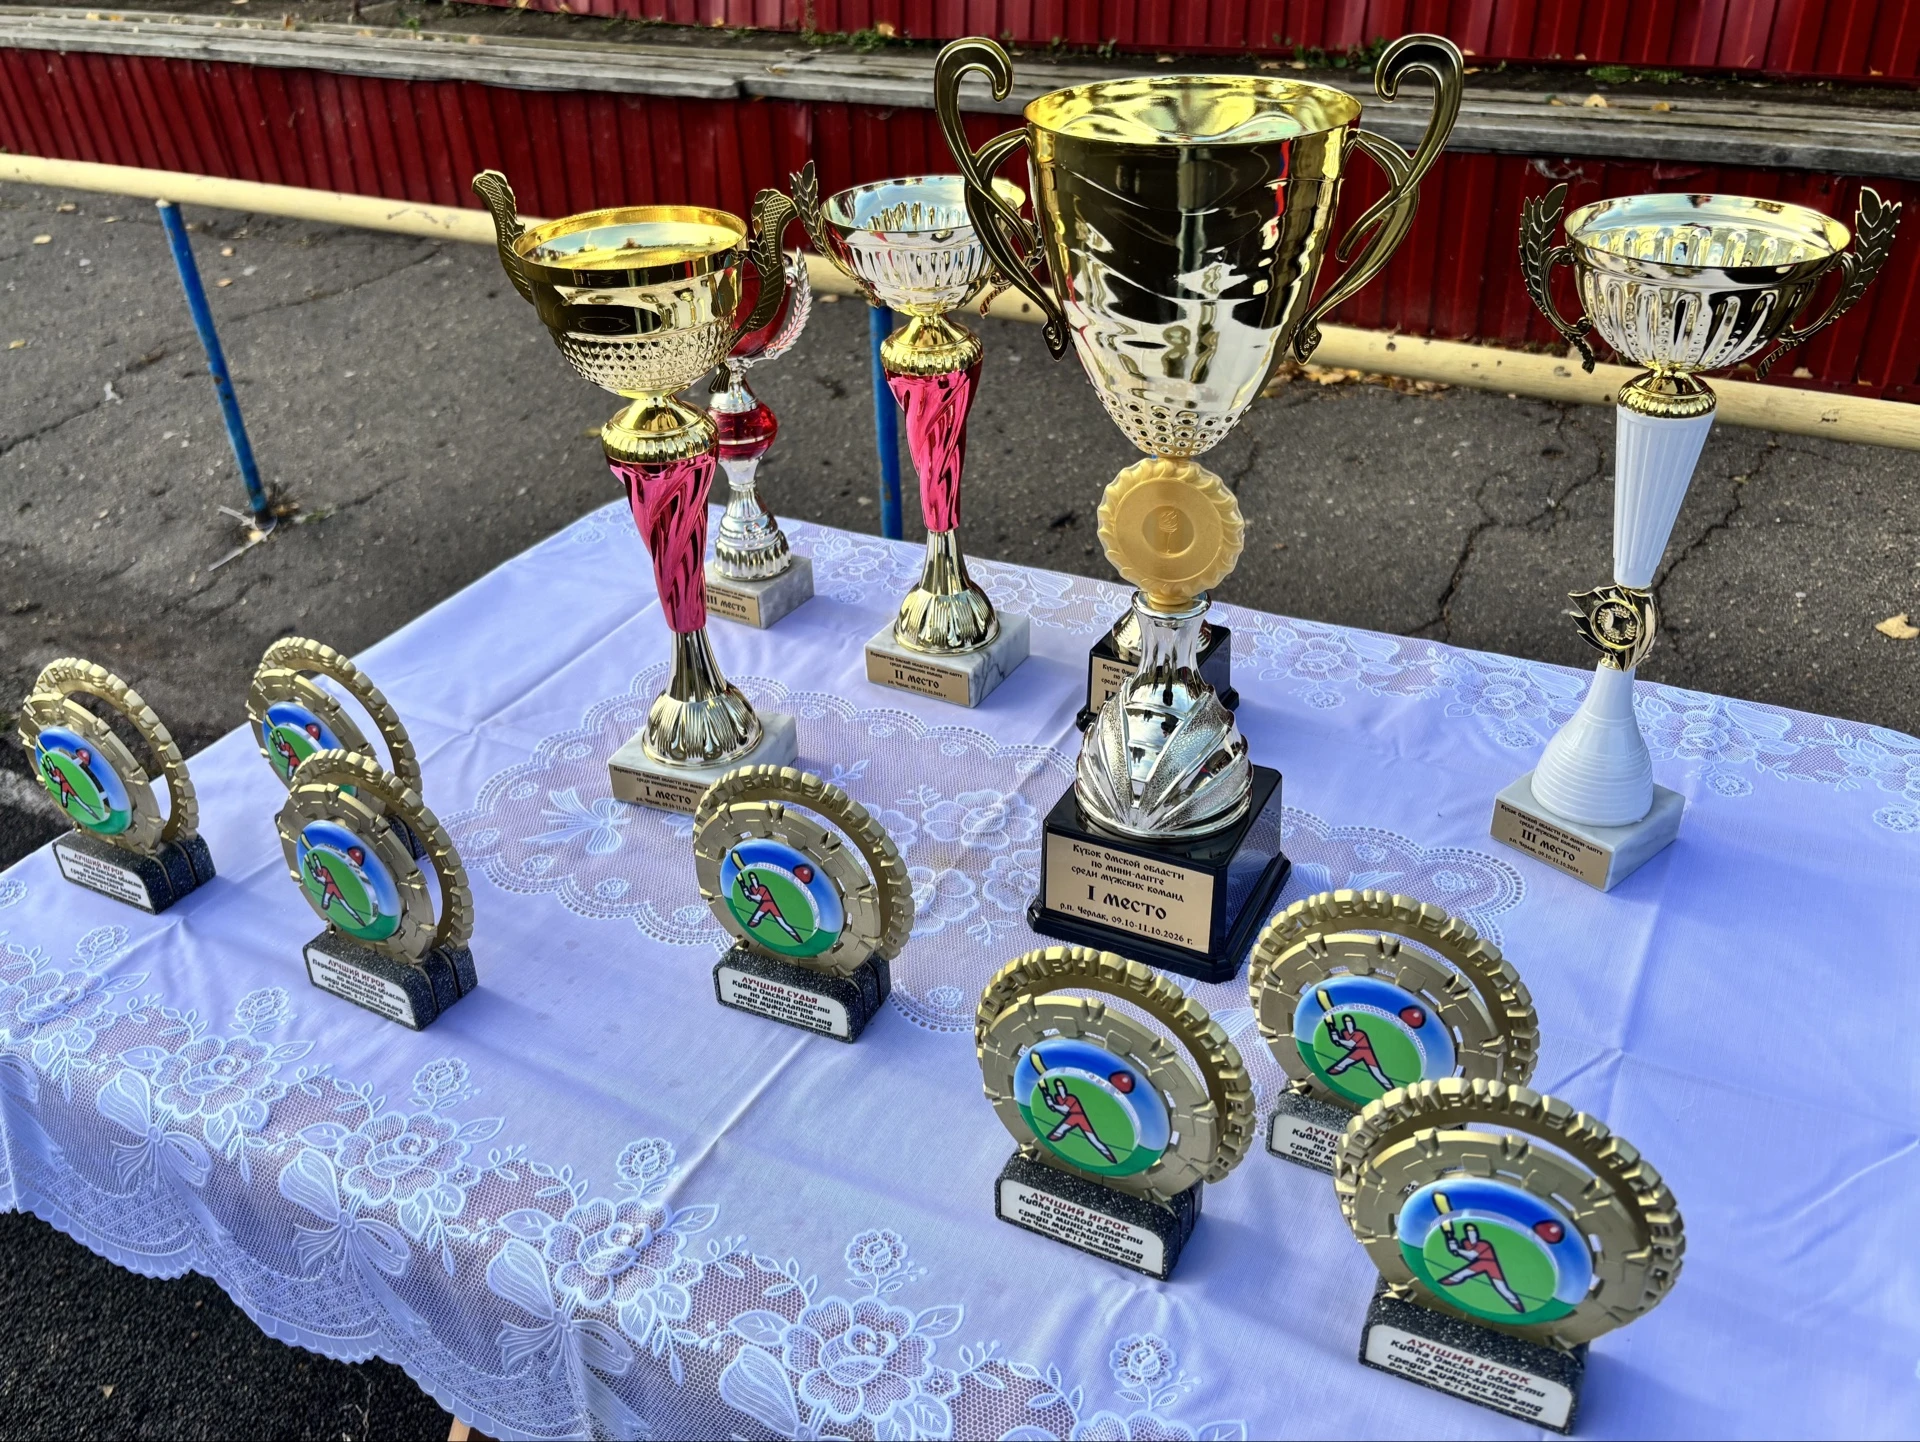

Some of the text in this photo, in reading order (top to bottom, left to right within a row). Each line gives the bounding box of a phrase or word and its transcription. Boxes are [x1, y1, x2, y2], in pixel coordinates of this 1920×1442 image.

[720, 600, 746, 612] место
[894, 669, 940, 689] II место
[1101, 678, 1118, 687] среди
[1102, 664, 1120, 674] Кубок
[645, 786, 692, 805] I место
[1500, 804, 1516, 816] Кубок
[1518, 812, 1538, 825] Омской
[1538, 822, 1561, 836] области
[1570, 837, 1603, 856] мини-лапте
[1519, 820, 1581, 853] среди мужских команд
[1521, 828, 1576, 862] III место
[1073, 844, 1185, 881] Кубок Омской области
[1091, 860, 1164, 886] по мини-лапте
[1072, 866, 1184, 903] среди мужских команд
[1087, 884, 1167, 920] I место
[1060, 902, 1074, 912] р.п.
[1077, 905, 1108, 922] Черлак,
[1112, 915, 1184, 943] 09.10-11.10.2026
[328, 959, 386, 989] ЛУЧШИЙ ИГРОК
[352, 976, 376, 991] Омской
[378, 988, 406, 1003] области
[742, 976, 818, 1004] ЛУЧШИЙ СУДЬЯ
[322, 974, 340, 987] среди
[379, 998, 403, 1014] команд
[732, 979, 830, 1014] Кубка Омской области
[733, 992, 832, 1027] среди мужских команд
[762, 996, 814, 1015] мини-лапте
[1290, 1142, 1322, 1157] среди
[1292, 1128, 1325, 1144] Кубка
[1314, 1144, 1326, 1152] по
[1018, 1194, 1144, 1246] Кубка Омской области
[1031, 1192, 1131, 1234] ЛУЧШИЙ ИГРОК
[1040, 1210, 1121, 1244] по мини-лапте
[1018, 1208, 1144, 1260] среди мужских команд
[1032, 1221, 1062, 1236] Черлак,
[1064, 1232, 1082, 1244] 9-11
[1084, 1240, 1120, 1258] октября
[1120, 1253, 1142, 1265] 2026
[1390, 1340, 1546, 1398] Кубка Омской области
[1406, 1338, 1532, 1386] ЛУЧШИЙ ИГРОК
[1415, 1356, 1516, 1395] по мини-лапте
[1387, 1354, 1544, 1413] среди мужских команд
[1404, 1366, 1440, 1384] Черлак,
[1444, 1380, 1465, 1394] 9-11
[1468, 1389, 1511, 1409] октября
[1512, 1404, 1540, 1417] 2026
